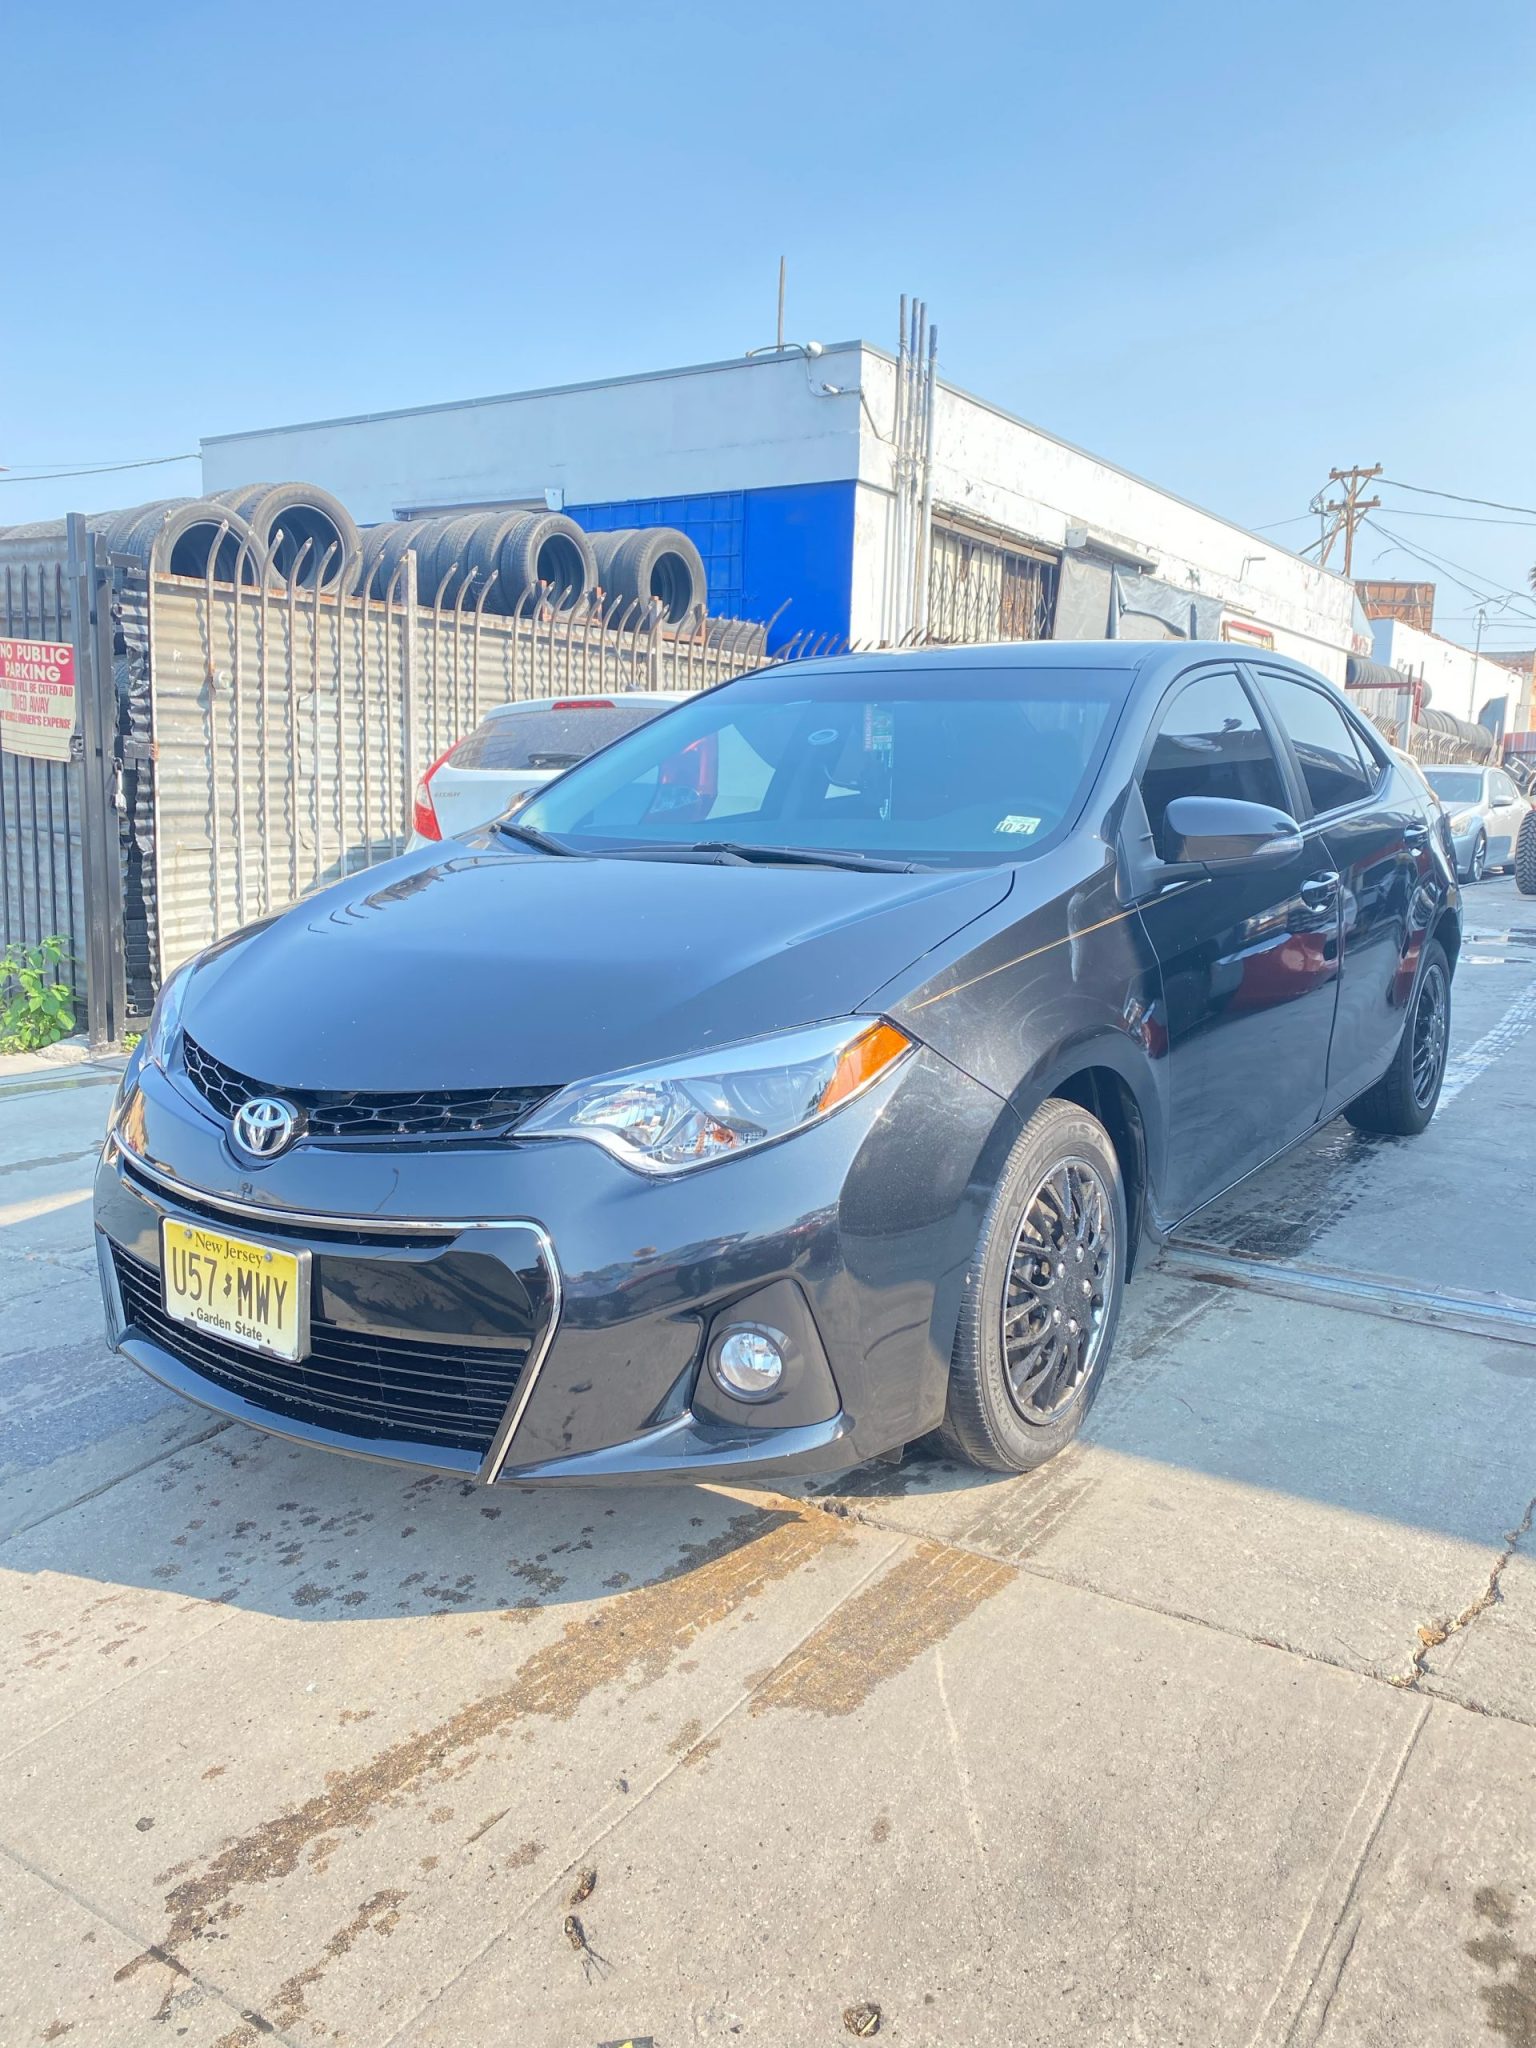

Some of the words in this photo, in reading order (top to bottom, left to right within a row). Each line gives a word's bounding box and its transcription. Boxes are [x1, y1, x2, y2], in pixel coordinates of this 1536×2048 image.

[0, 643, 12, 660] NO
[17, 644, 70, 665] PUBLIC
[5, 661, 61, 682] PARKING
[30, 682, 37, 693] BE
[38, 683, 58, 696] CITED
[59, 686, 74, 697] AND
[29, 695, 49, 714] AWAY
[43, 716, 71, 729] EXPENSE
[999, 822, 1013, 832] 10
[1015, 823, 1030, 833] 21
[195, 1231, 223, 1254] New
[223, 1241, 263, 1269] Jersey
[172, 1246, 218, 1307] U57
[237, 1267, 288, 1330] MWY
[196, 1307, 231, 1331] Garden
[234, 1320, 262, 1342] State
